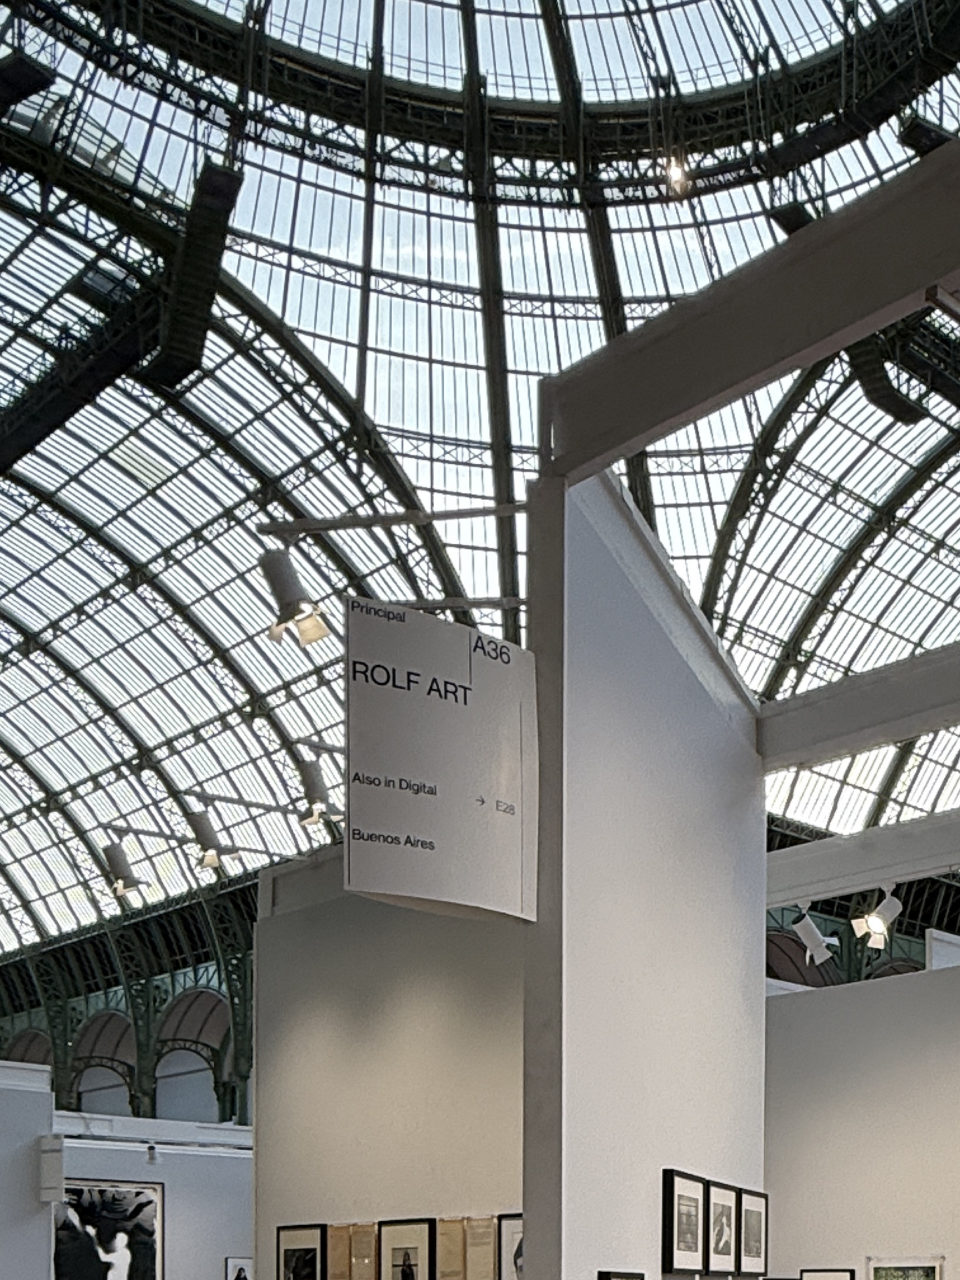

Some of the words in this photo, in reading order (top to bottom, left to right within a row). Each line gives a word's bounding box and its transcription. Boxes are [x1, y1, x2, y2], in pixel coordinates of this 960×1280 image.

[351, 600, 406, 623] Principal
[473, 635, 511, 665] A36
[352, 660, 421, 691] ROLF
[426, 677, 472, 706] ART
[352, 772, 382, 787] Also
[384, 776, 395, 789] in
[399, 778, 437, 796] Digital
[352, 828, 401, 845] Buenos
[403, 835, 436, 851] Aires
